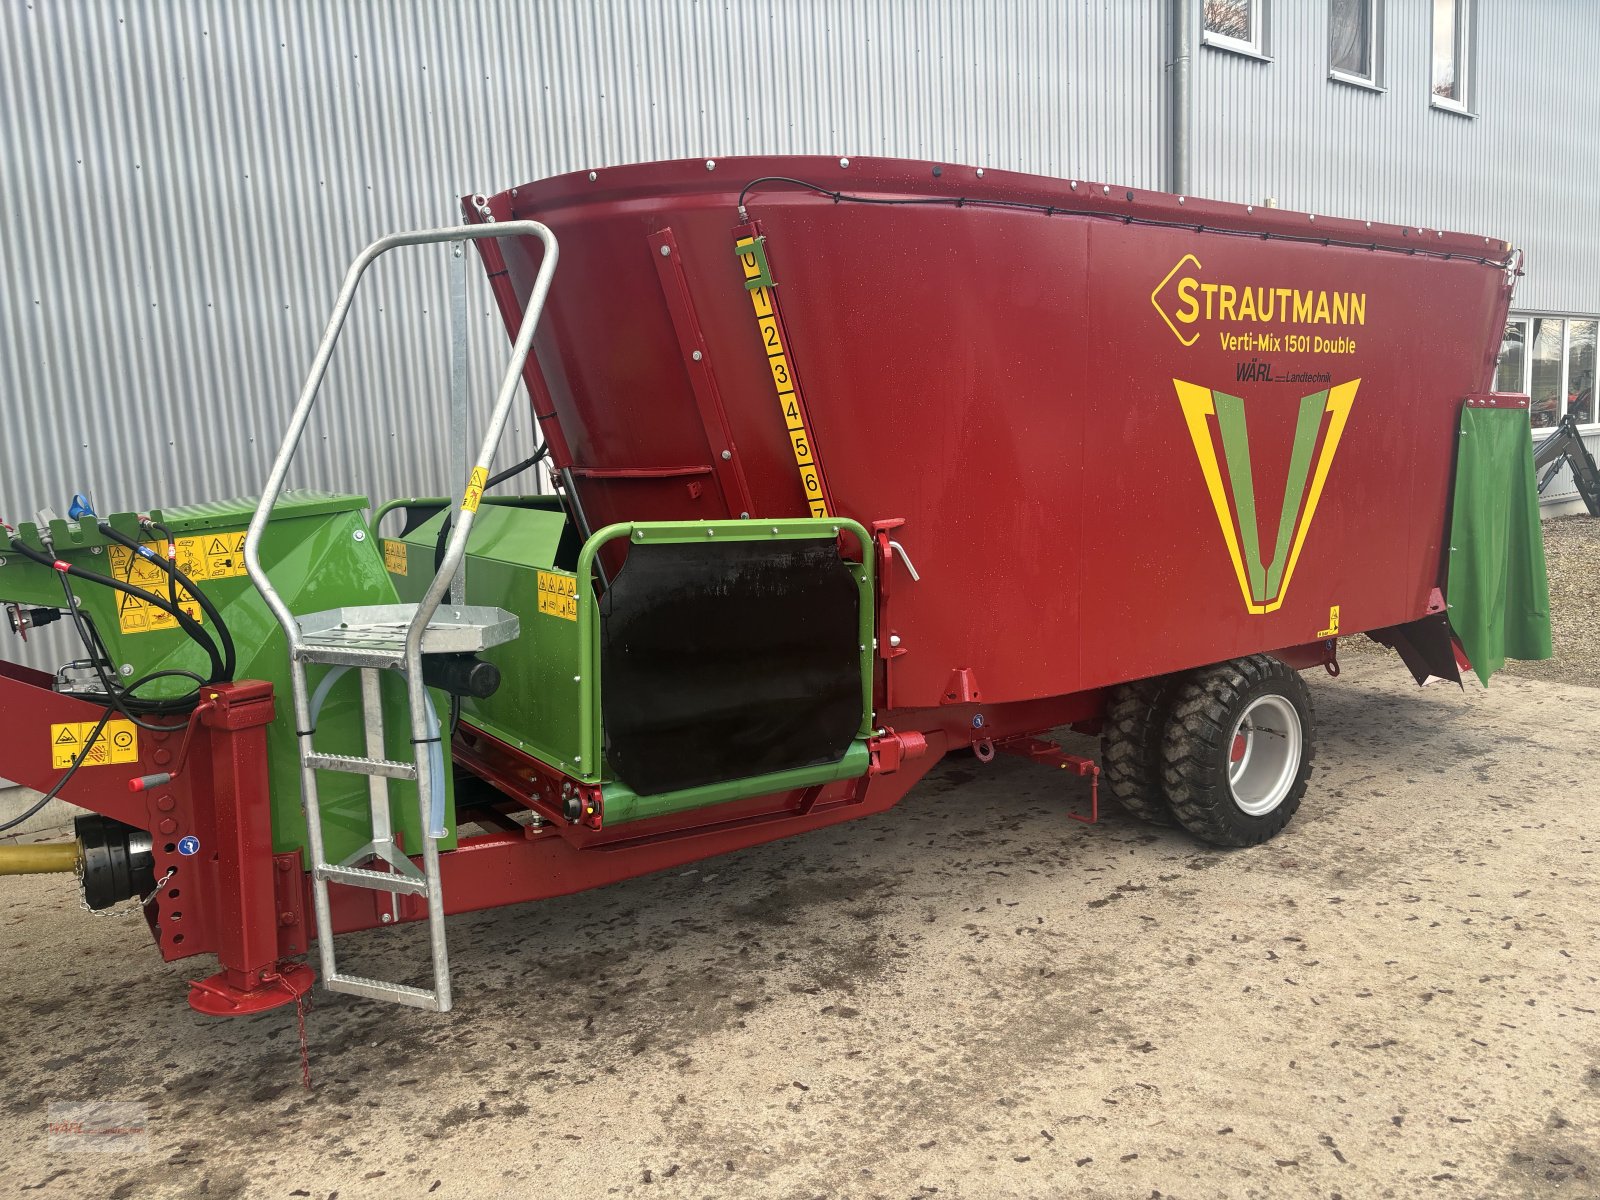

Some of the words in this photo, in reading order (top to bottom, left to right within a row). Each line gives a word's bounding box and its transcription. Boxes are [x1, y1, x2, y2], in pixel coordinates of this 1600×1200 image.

[744, 252, 756, 268] 0
[756, 287, 766, 306] 1
[1175, 277, 1366, 325] STRAUTMANN
[764, 326, 778, 347] 2
[1220, 332, 1281, 352] Verti-Mix
[1284, 335, 1310, 353] 1501
[1314, 336, 1356, 354] Double
[774, 364, 788, 384] 3
[1236, 358, 1274, 382] WÄRL
[1285, 371, 1331, 383] Landtechnik
[786, 401, 798, 420] 4
[795, 438, 808, 456] 5
[805, 474, 818, 491] 6
